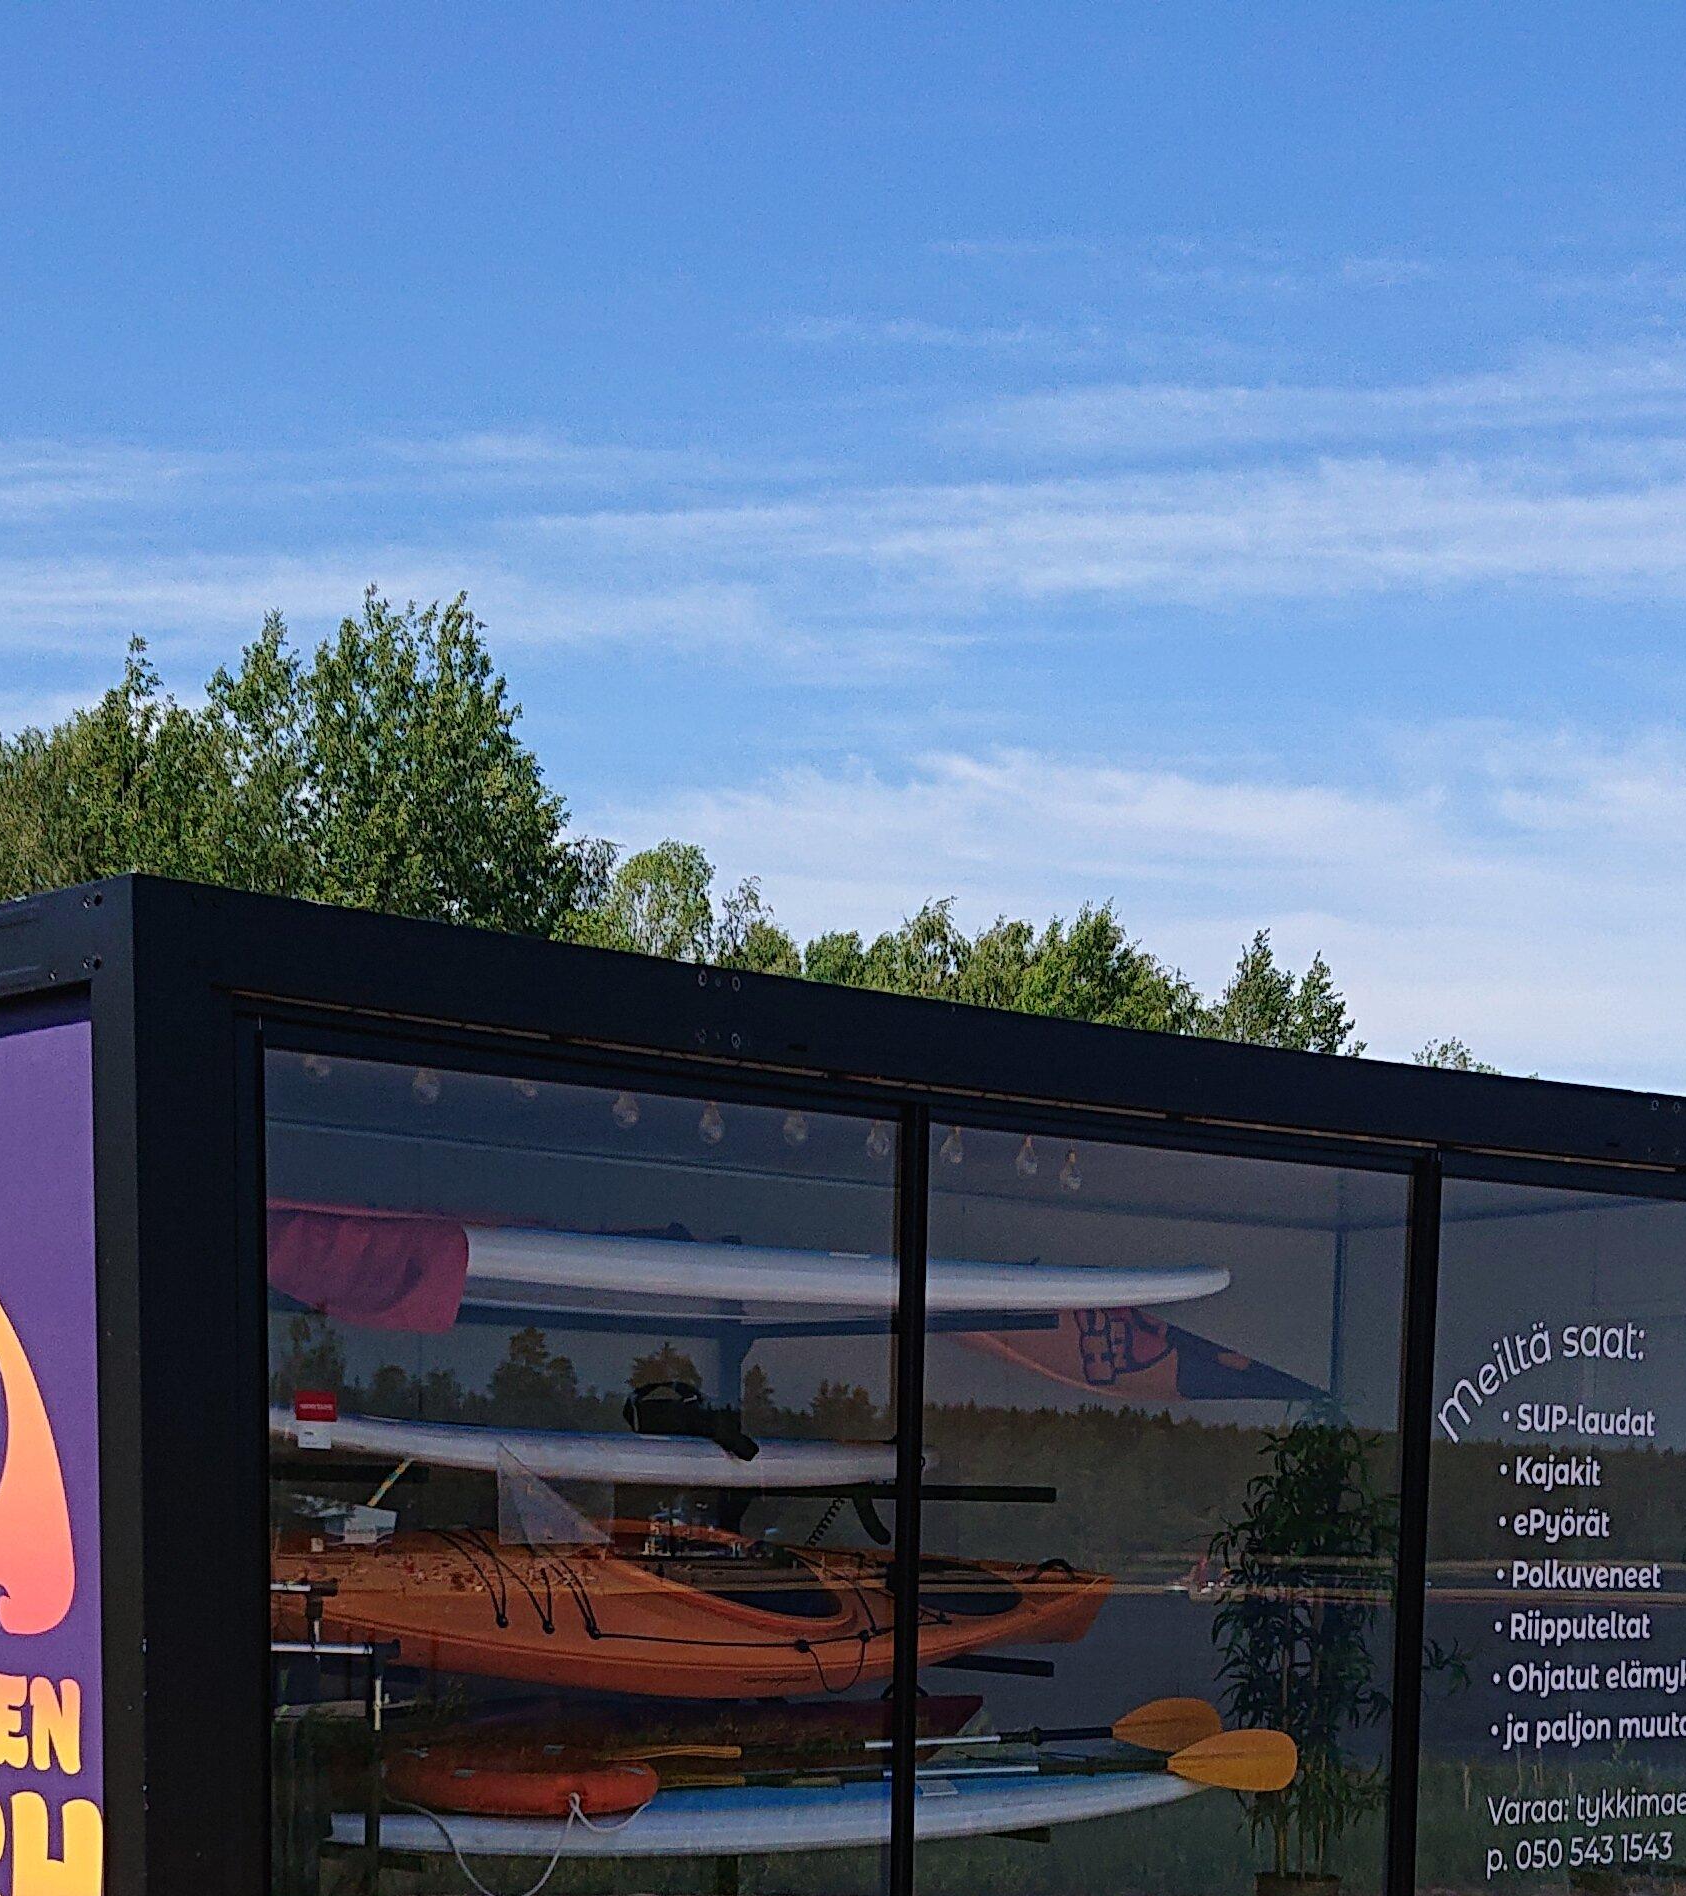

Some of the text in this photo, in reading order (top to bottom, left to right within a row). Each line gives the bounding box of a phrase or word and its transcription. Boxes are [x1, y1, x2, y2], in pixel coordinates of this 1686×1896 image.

[1437, 1321, 1645, 1444] meiltä saat:
[1516, 1403, 1656, 1437] SUP-laudat
[1515, 1454, 1602, 1492] Kajakit
[1513, 1507, 1610, 1542] ePyörät
[1512, 1559, 1661, 1590] Polkuveneet
[1510, 1609, 1651, 1648] Riipputeltat
[1508, 1660, 1600, 1698] Ohjatut
[1502, 1712, 1529, 1751] ja
[1535, 1710, 1611, 1749] paljon
[1487, 1795, 1570, 1826] Varaa:
[1486, 1831, 1673, 1880] p. 050 543 1543
